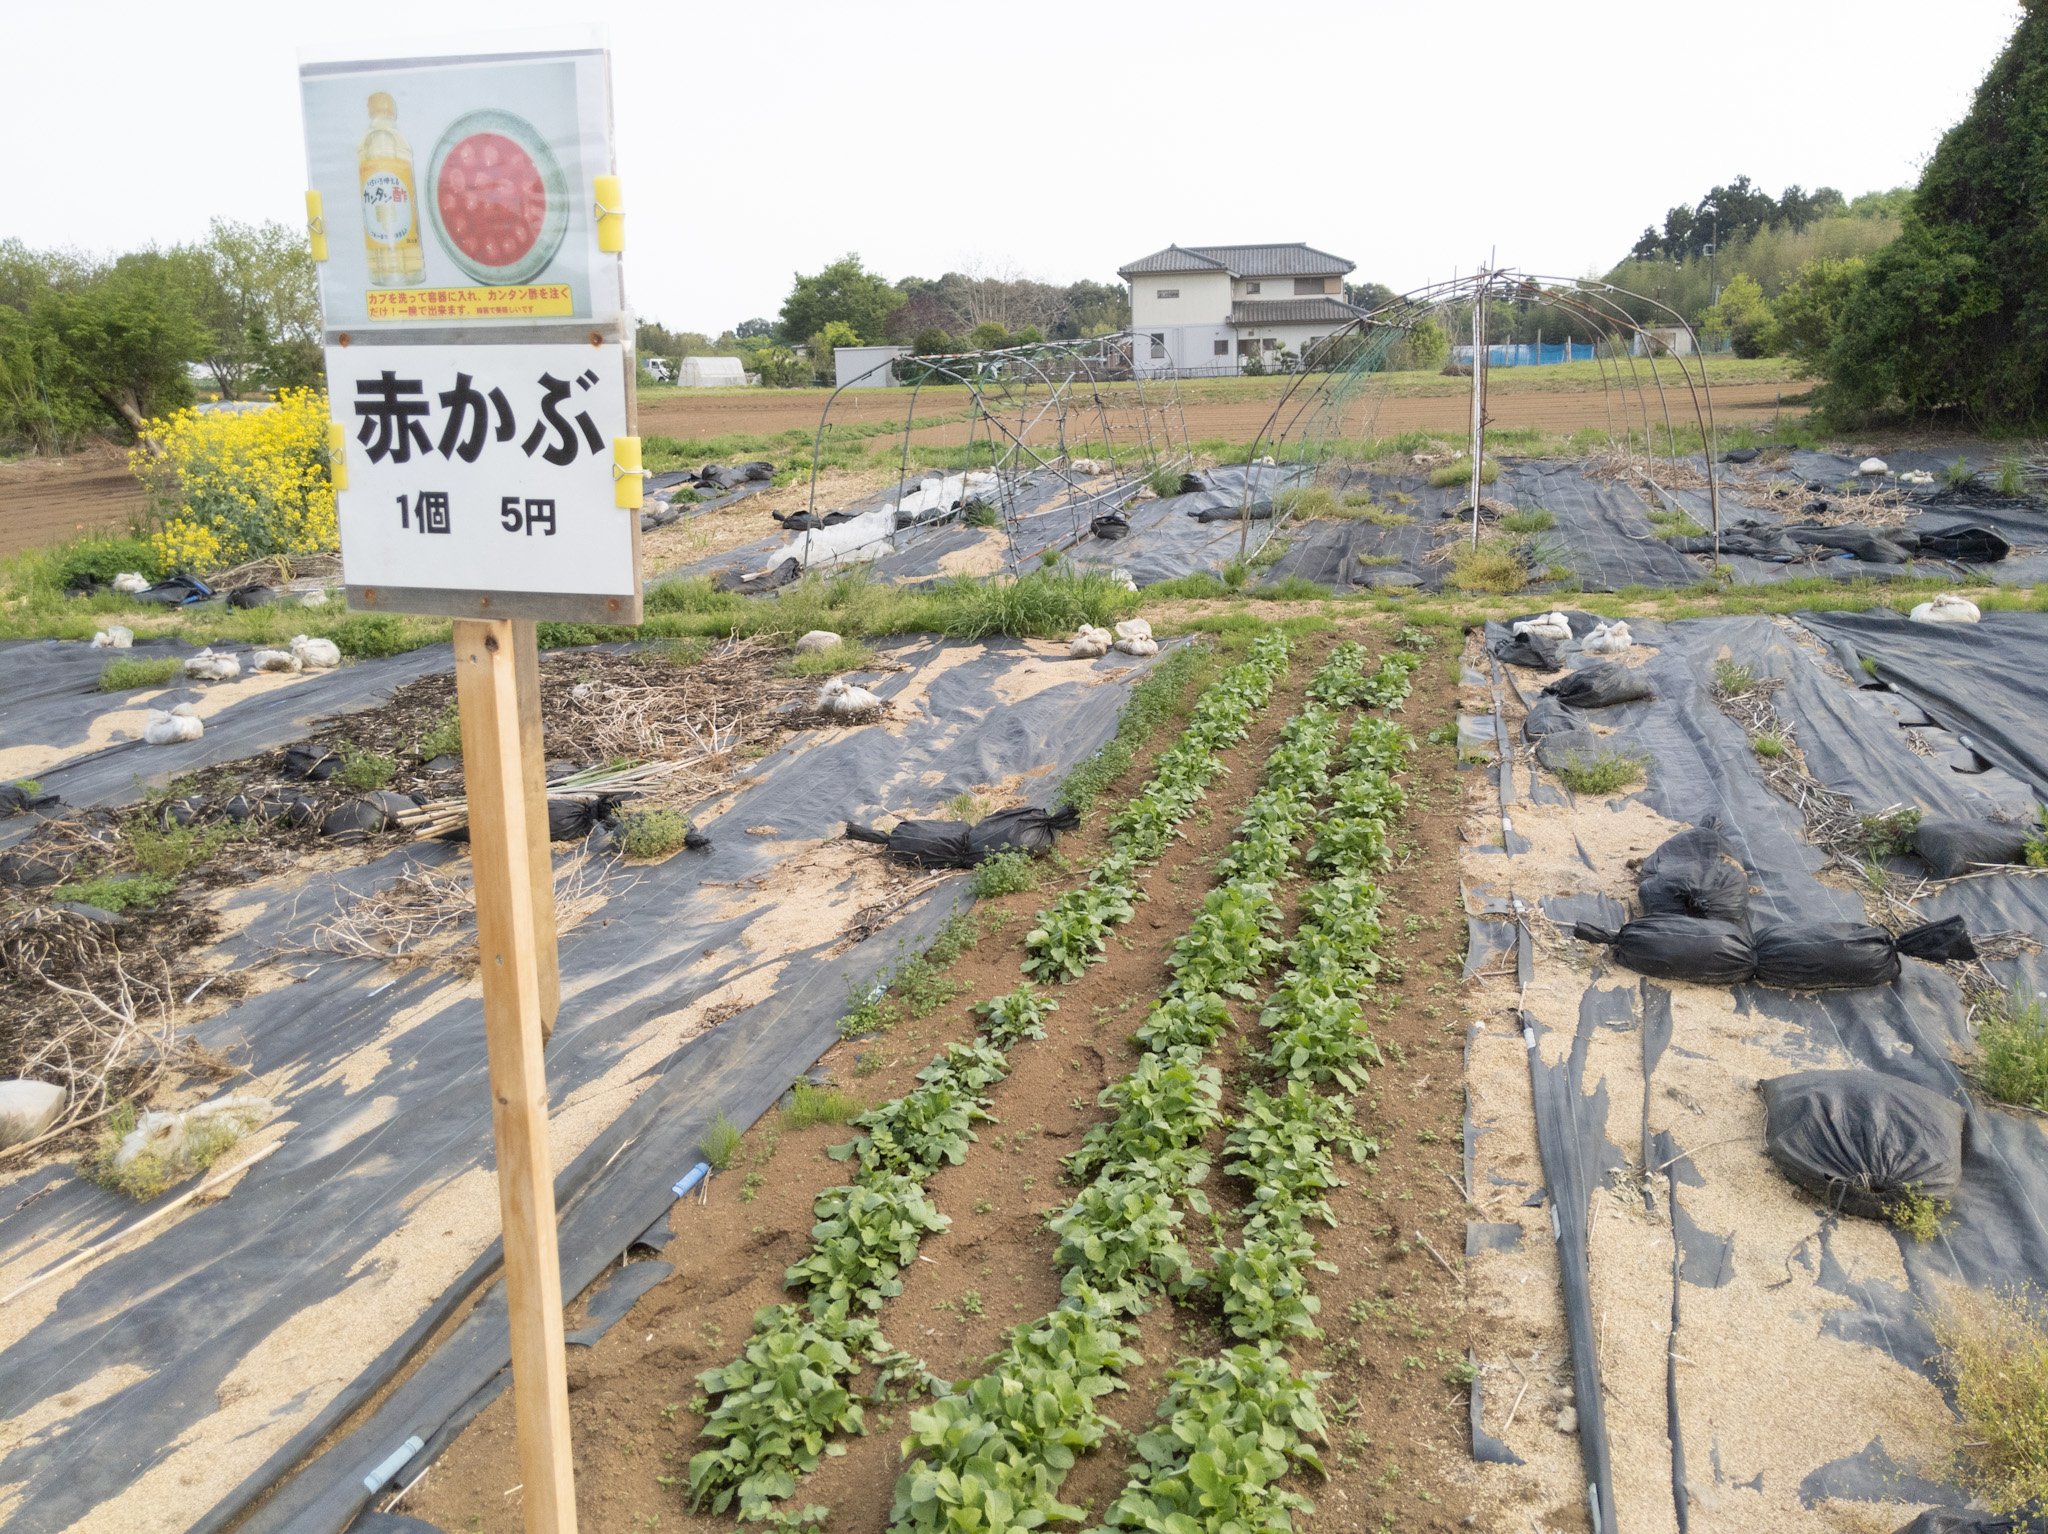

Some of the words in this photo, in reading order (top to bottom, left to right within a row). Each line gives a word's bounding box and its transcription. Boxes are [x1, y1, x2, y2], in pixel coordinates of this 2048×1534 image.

[363, 186, 408, 205] カンタン酢
[354, 368, 606, 466] 赤かぶ
[396, 490, 451, 534] 1個
[501, 496, 557, 536] 5円
